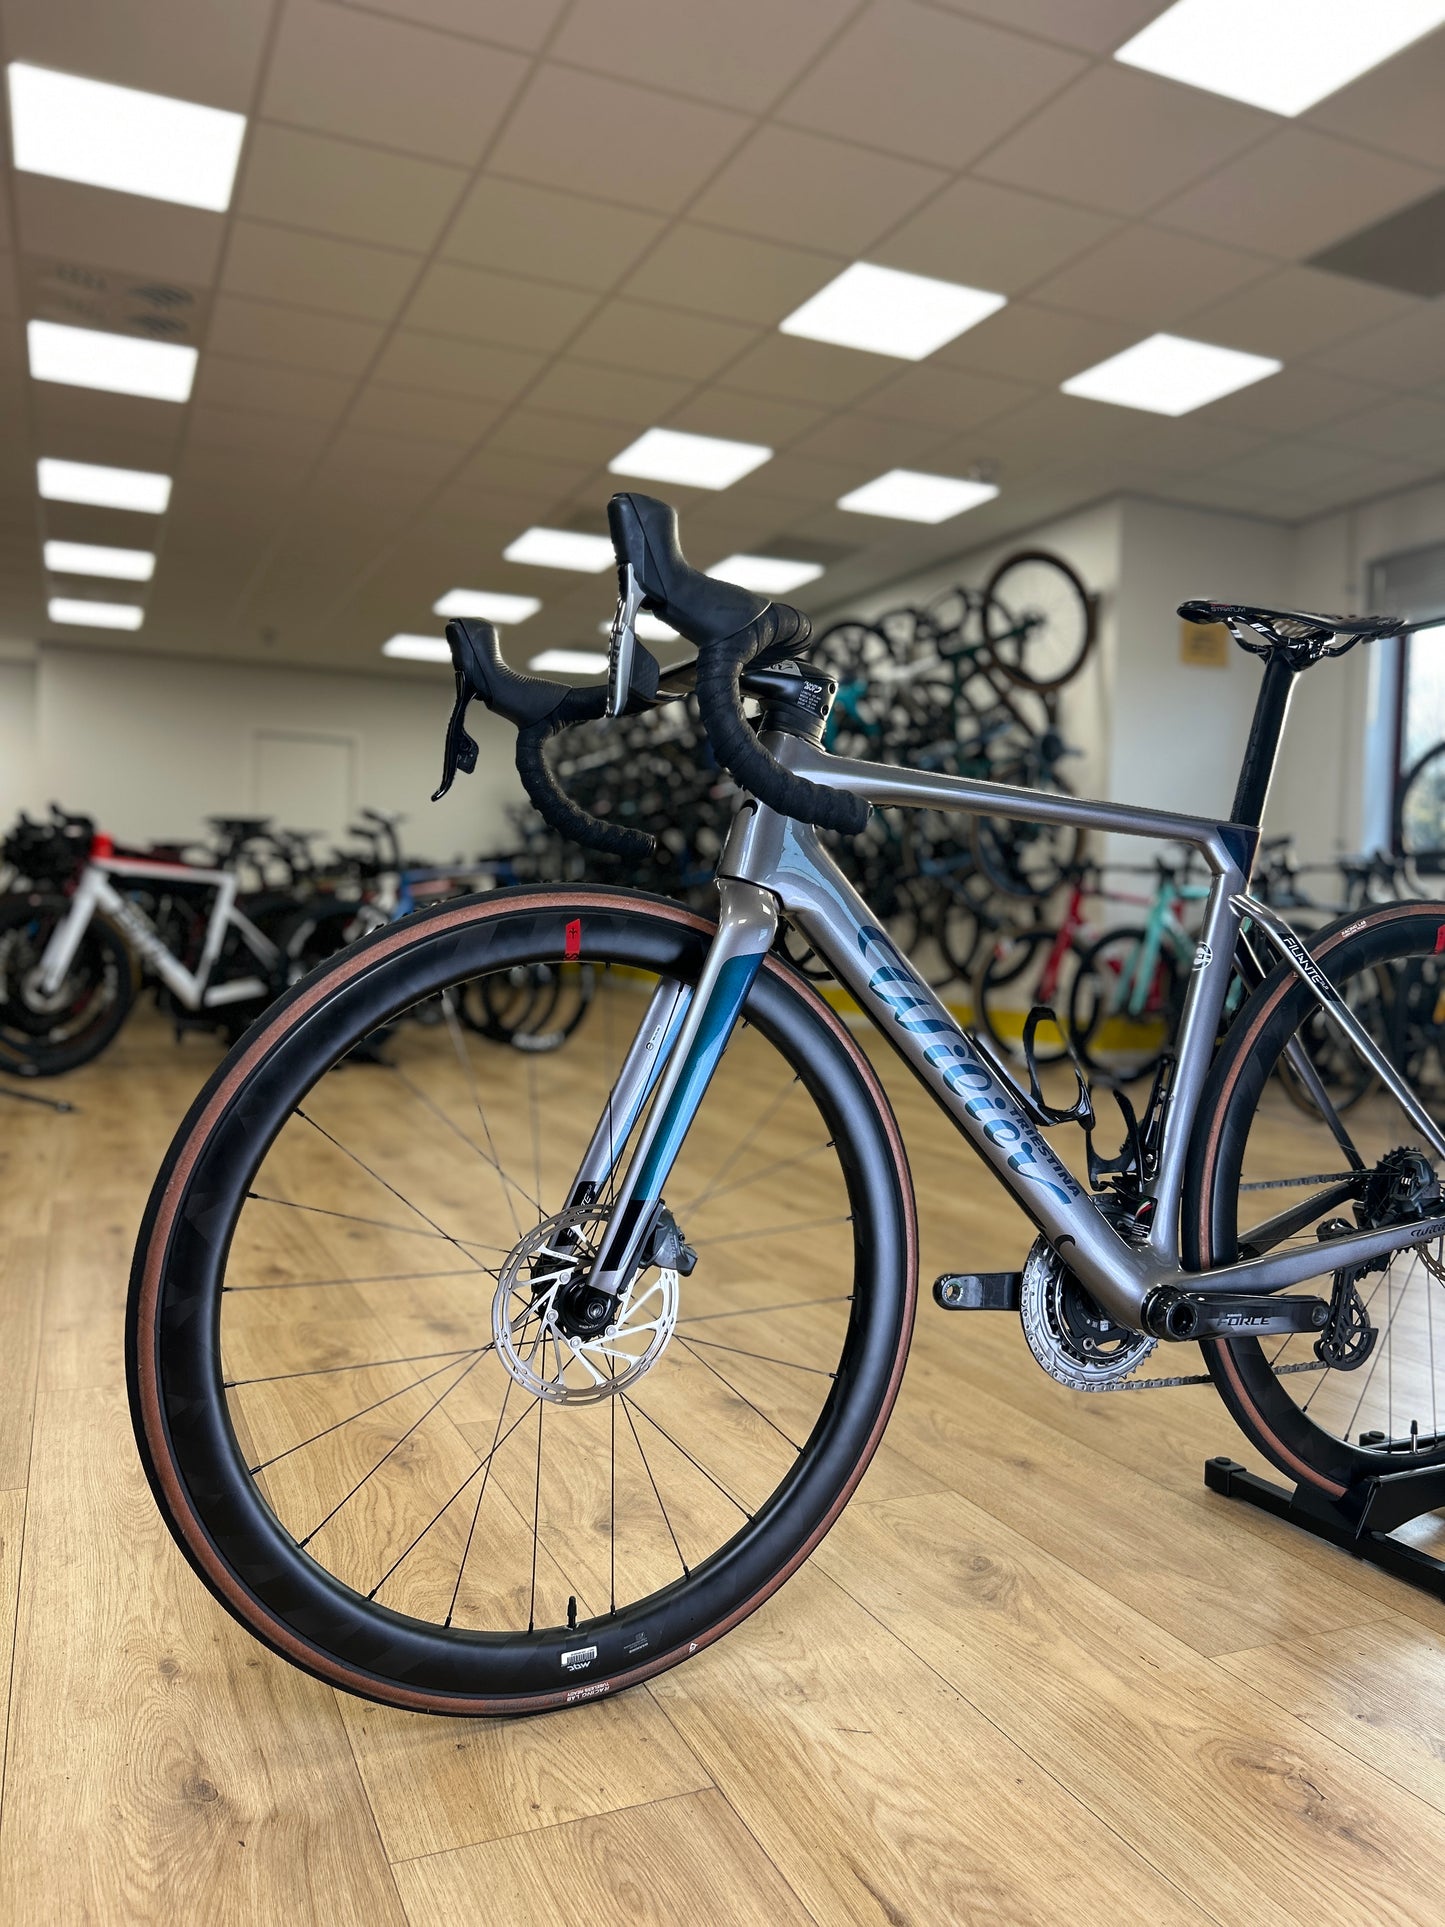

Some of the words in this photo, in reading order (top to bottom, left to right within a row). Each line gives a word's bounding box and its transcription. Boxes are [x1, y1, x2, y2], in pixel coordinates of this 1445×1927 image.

[1283, 938, 1321, 983] FILANTE
[1009, 1106, 1080, 1198] TRIESTINA
[1217, 1315, 1270, 1326] FORCE
[582, 1686, 610, 1697] RACING
[566, 1694, 580, 1702] LAB
